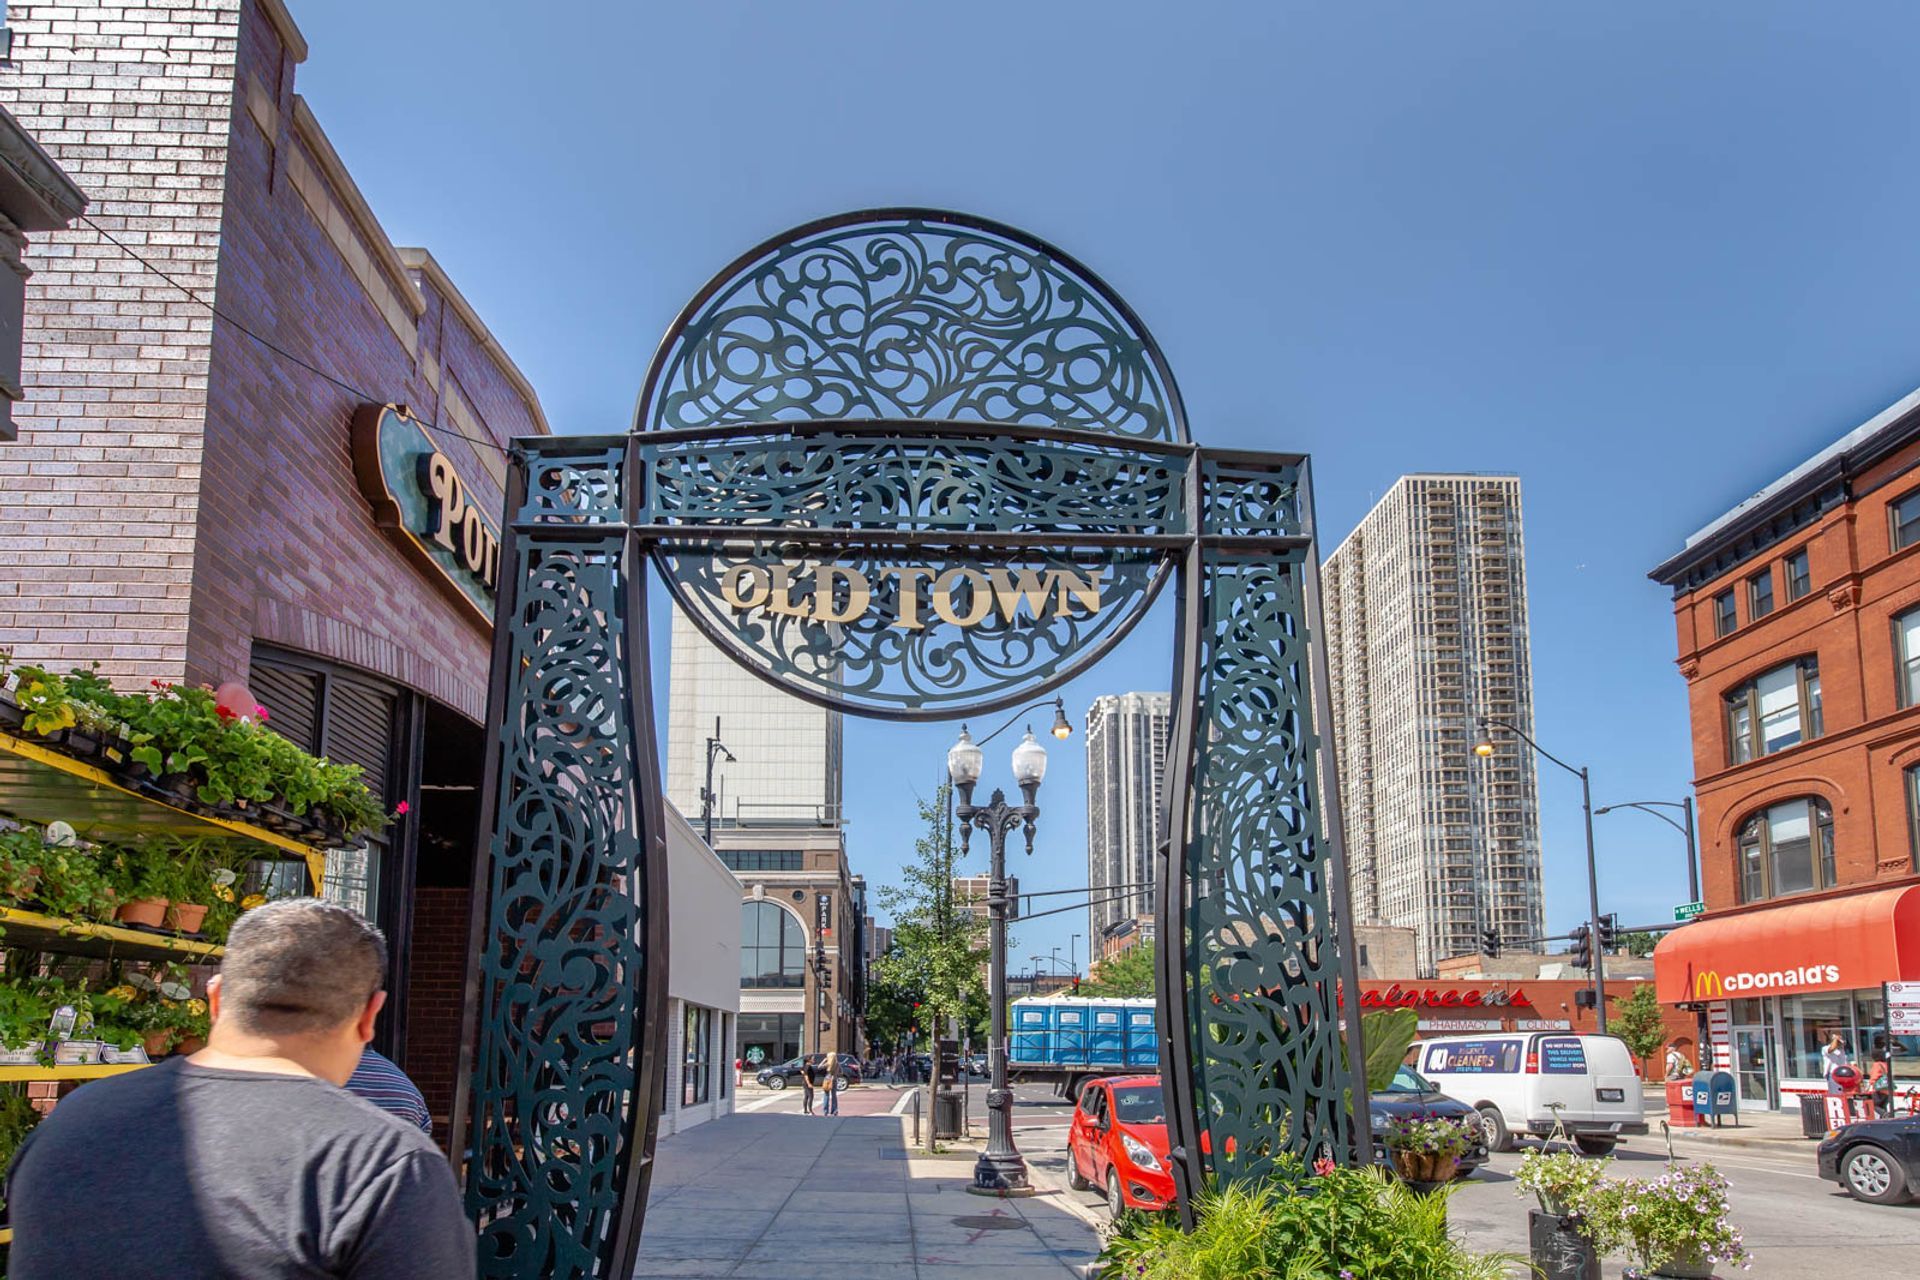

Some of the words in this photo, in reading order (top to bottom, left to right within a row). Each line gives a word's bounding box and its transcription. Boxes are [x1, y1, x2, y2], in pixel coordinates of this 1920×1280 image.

[430, 452, 500, 592] POT
[721, 564, 871, 624] OLD
[880, 566, 1101, 629] TOWN
[1679, 903, 1702, 914] WELLS
[1696, 964, 1840, 998] McDonald's
[1338, 983, 1532, 1008] algreens
[1429, 1020, 1489, 1030] PHARMACY
[1526, 1020, 1561, 1030] CLINIC
[1447, 1054, 1496, 1067] CLEANERS
